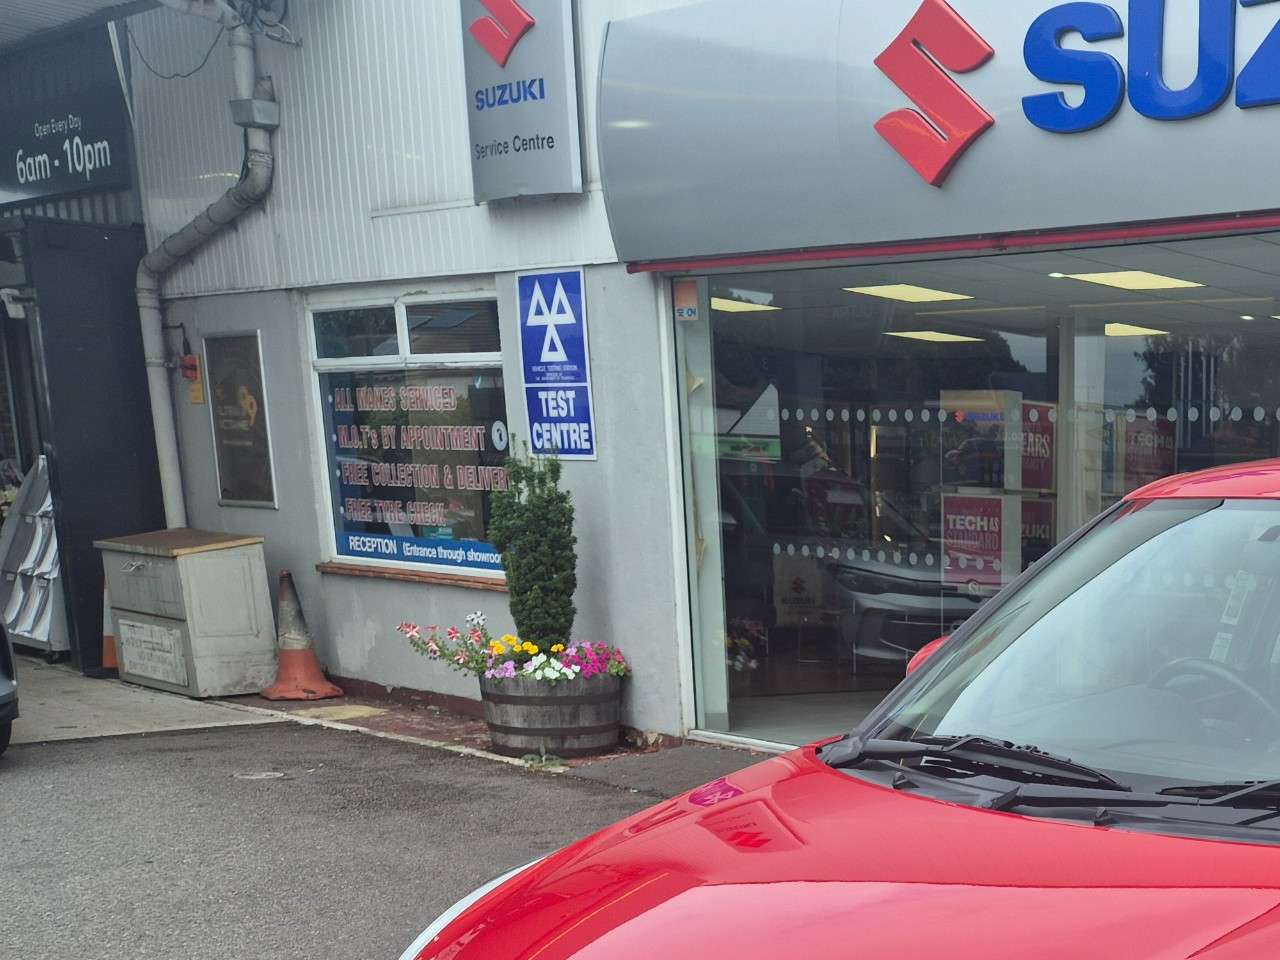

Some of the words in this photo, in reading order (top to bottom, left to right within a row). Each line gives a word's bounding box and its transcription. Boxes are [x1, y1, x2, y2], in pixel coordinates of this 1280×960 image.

[475, 78, 545, 111] SUZUKI
[34, 122, 51, 138] Open
[51, 118, 67, 134] Every
[68, 114, 82, 130] Day
[15, 149, 51, 184] 6am
[63, 136, 111, 181] 10pm
[474, 140, 509, 160] Service
[512, 134, 555, 152] Centre
[335, 387, 355, 412] ALL
[356, 386, 397, 411] MAKES
[400, 385, 457, 411] SERVICED
[538, 390, 576, 418] TEST
[381, 425, 397, 449] BY
[401, 425, 486, 451] APPOINTMENT
[532, 422, 591, 449] CENTRE
[341, 463, 369, 485] FREE
[371, 462, 440, 489] COLLECTION
[443, 464, 454, 489] &
[457, 464, 511, 491] DELIVER
[345, 497, 372, 522] FREE
[375, 500, 402, 523] TYRE
[406, 501, 447, 526] CHECK
[946, 514, 989, 531] TECH
[349, 536, 398, 554] RECEPTION
[403, 542, 437, 559] (Entrance
[438, 546, 466, 563] through
[467, 549, 502, 564] showroo
[946, 529, 999, 551] STANDARD
